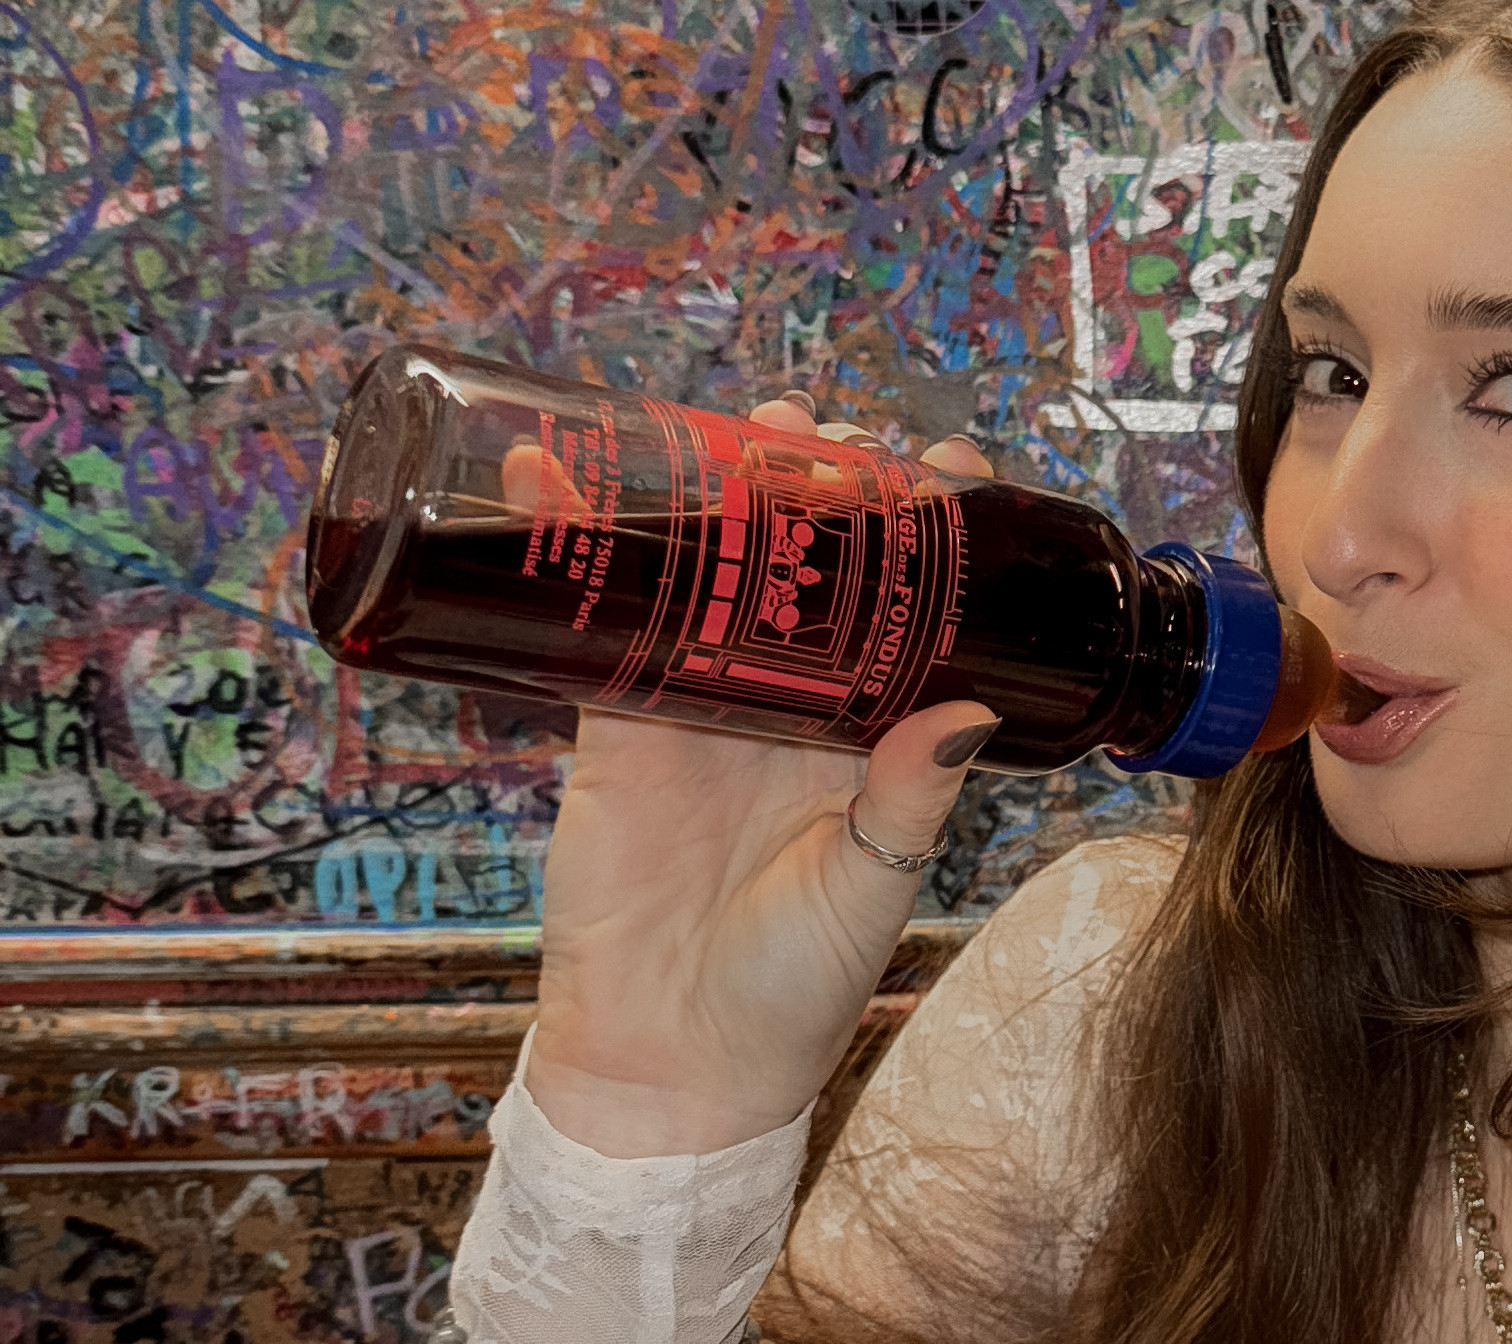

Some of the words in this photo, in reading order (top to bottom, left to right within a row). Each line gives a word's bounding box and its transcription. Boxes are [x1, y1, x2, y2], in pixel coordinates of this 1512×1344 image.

[573, 532, 592, 556] 48
[567, 557, 587, 581] 20
[588, 536, 615, 589] 75018
[894, 554, 909, 583] DES
[572, 589, 600, 632] Paris
[862, 582, 913, 697] FONDUS
